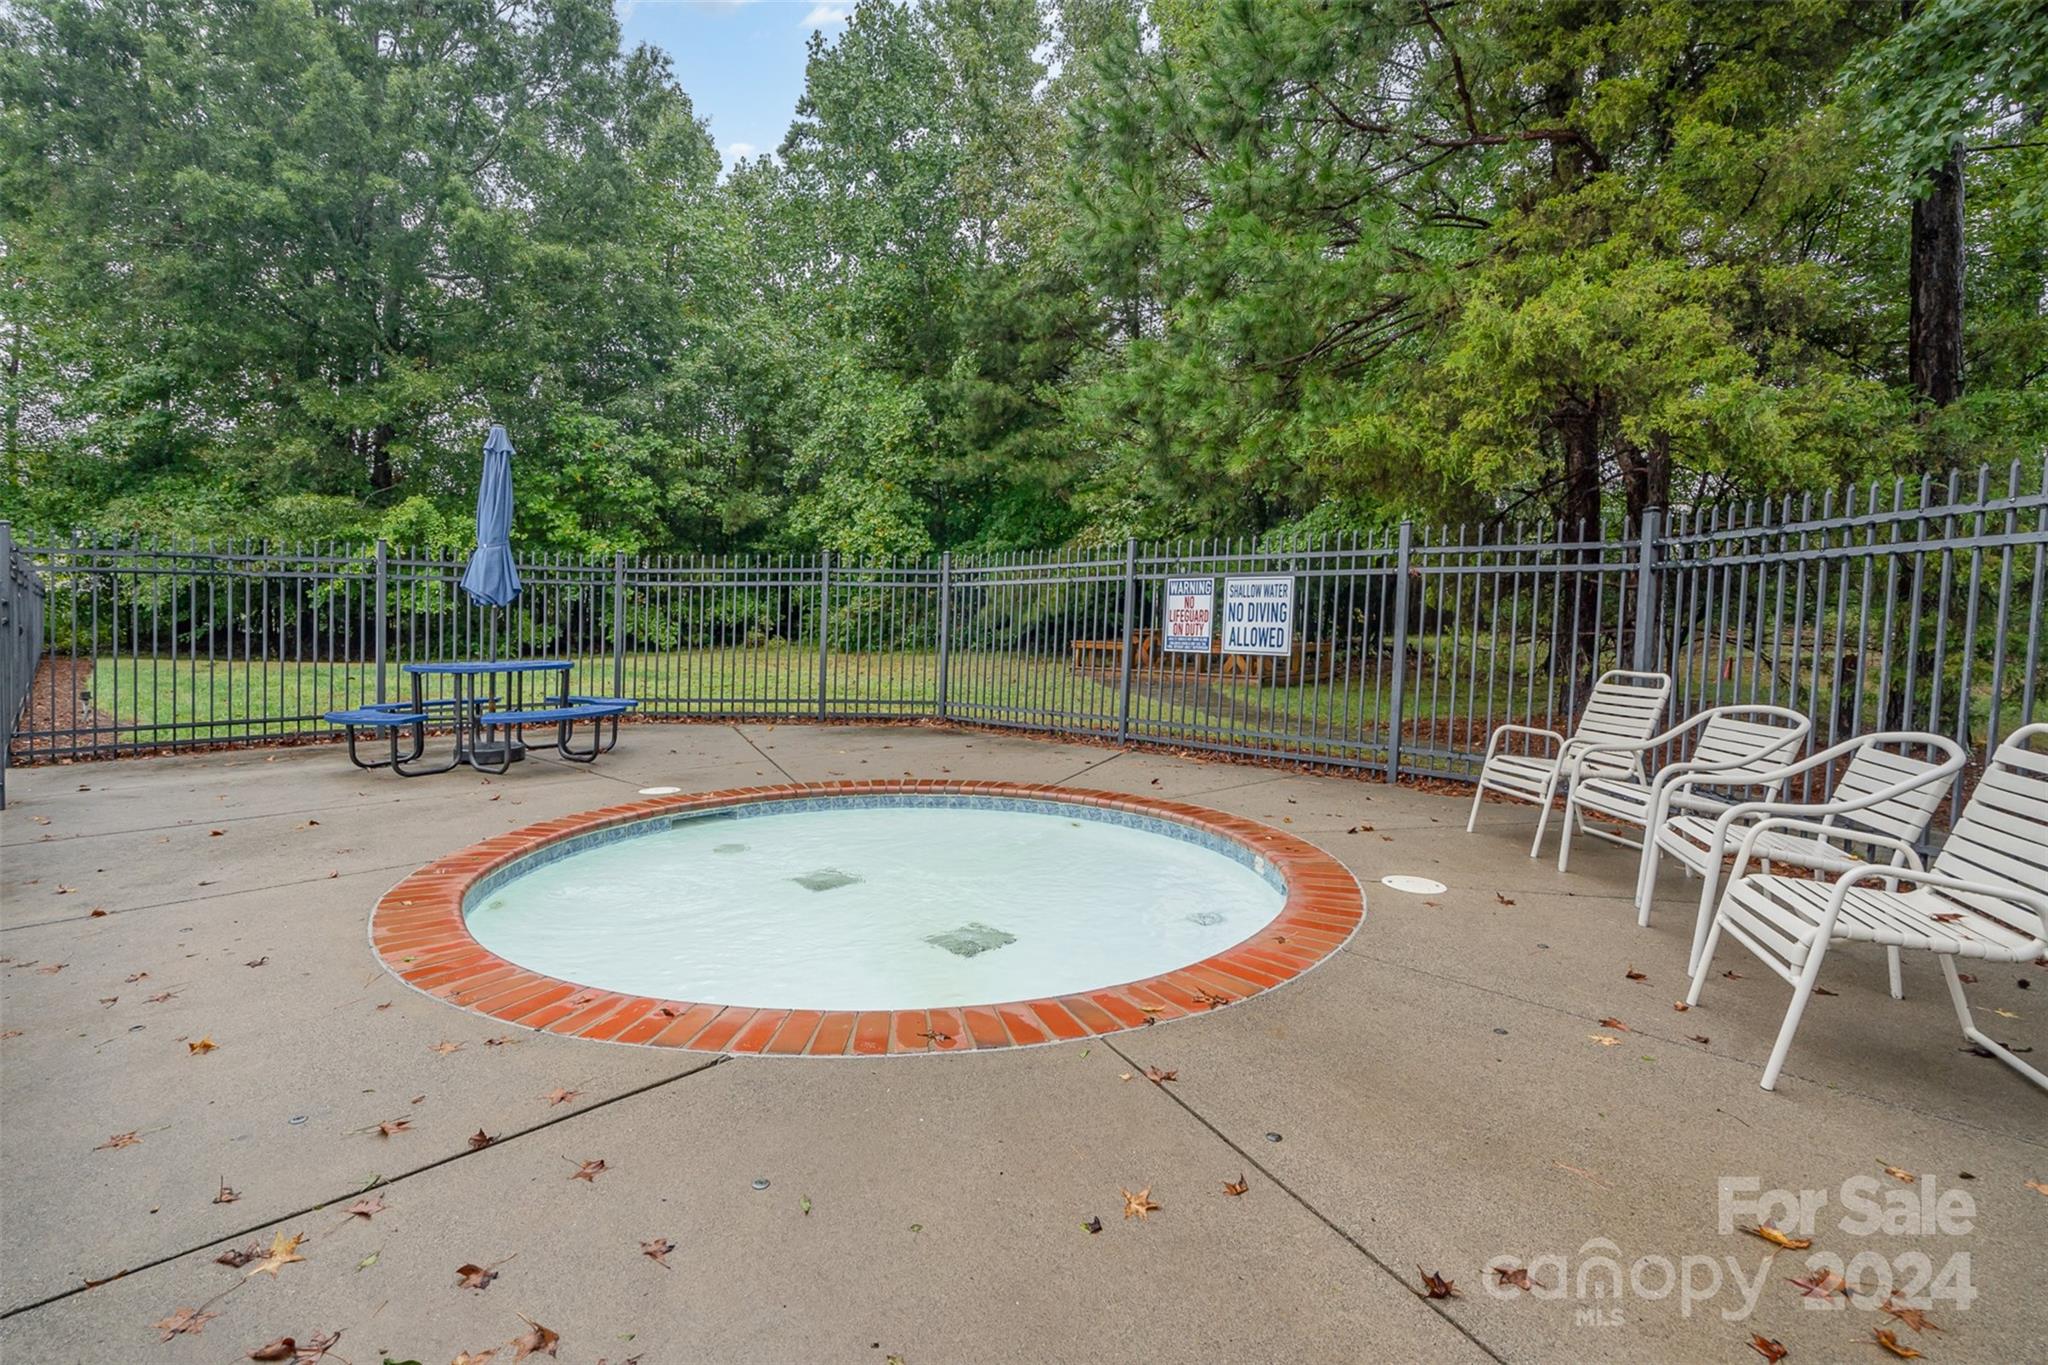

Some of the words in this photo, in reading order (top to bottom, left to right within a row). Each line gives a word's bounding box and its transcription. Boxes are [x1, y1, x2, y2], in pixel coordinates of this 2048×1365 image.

[1170, 581, 1211, 594] WARNING
[1229, 584, 1262, 598] SHALLOW
[1263, 583, 1288, 598] WATER
[1184, 596, 1195, 609] NO
[1169, 609, 1209, 623] LIFEGUARD
[1228, 602, 1244, 622] NO
[1248, 602, 1287, 623] DIVING
[1173, 623, 1183, 635] ON
[1185, 623, 1204, 636] DUTY
[1228, 626, 1284, 648] ALLOWED
